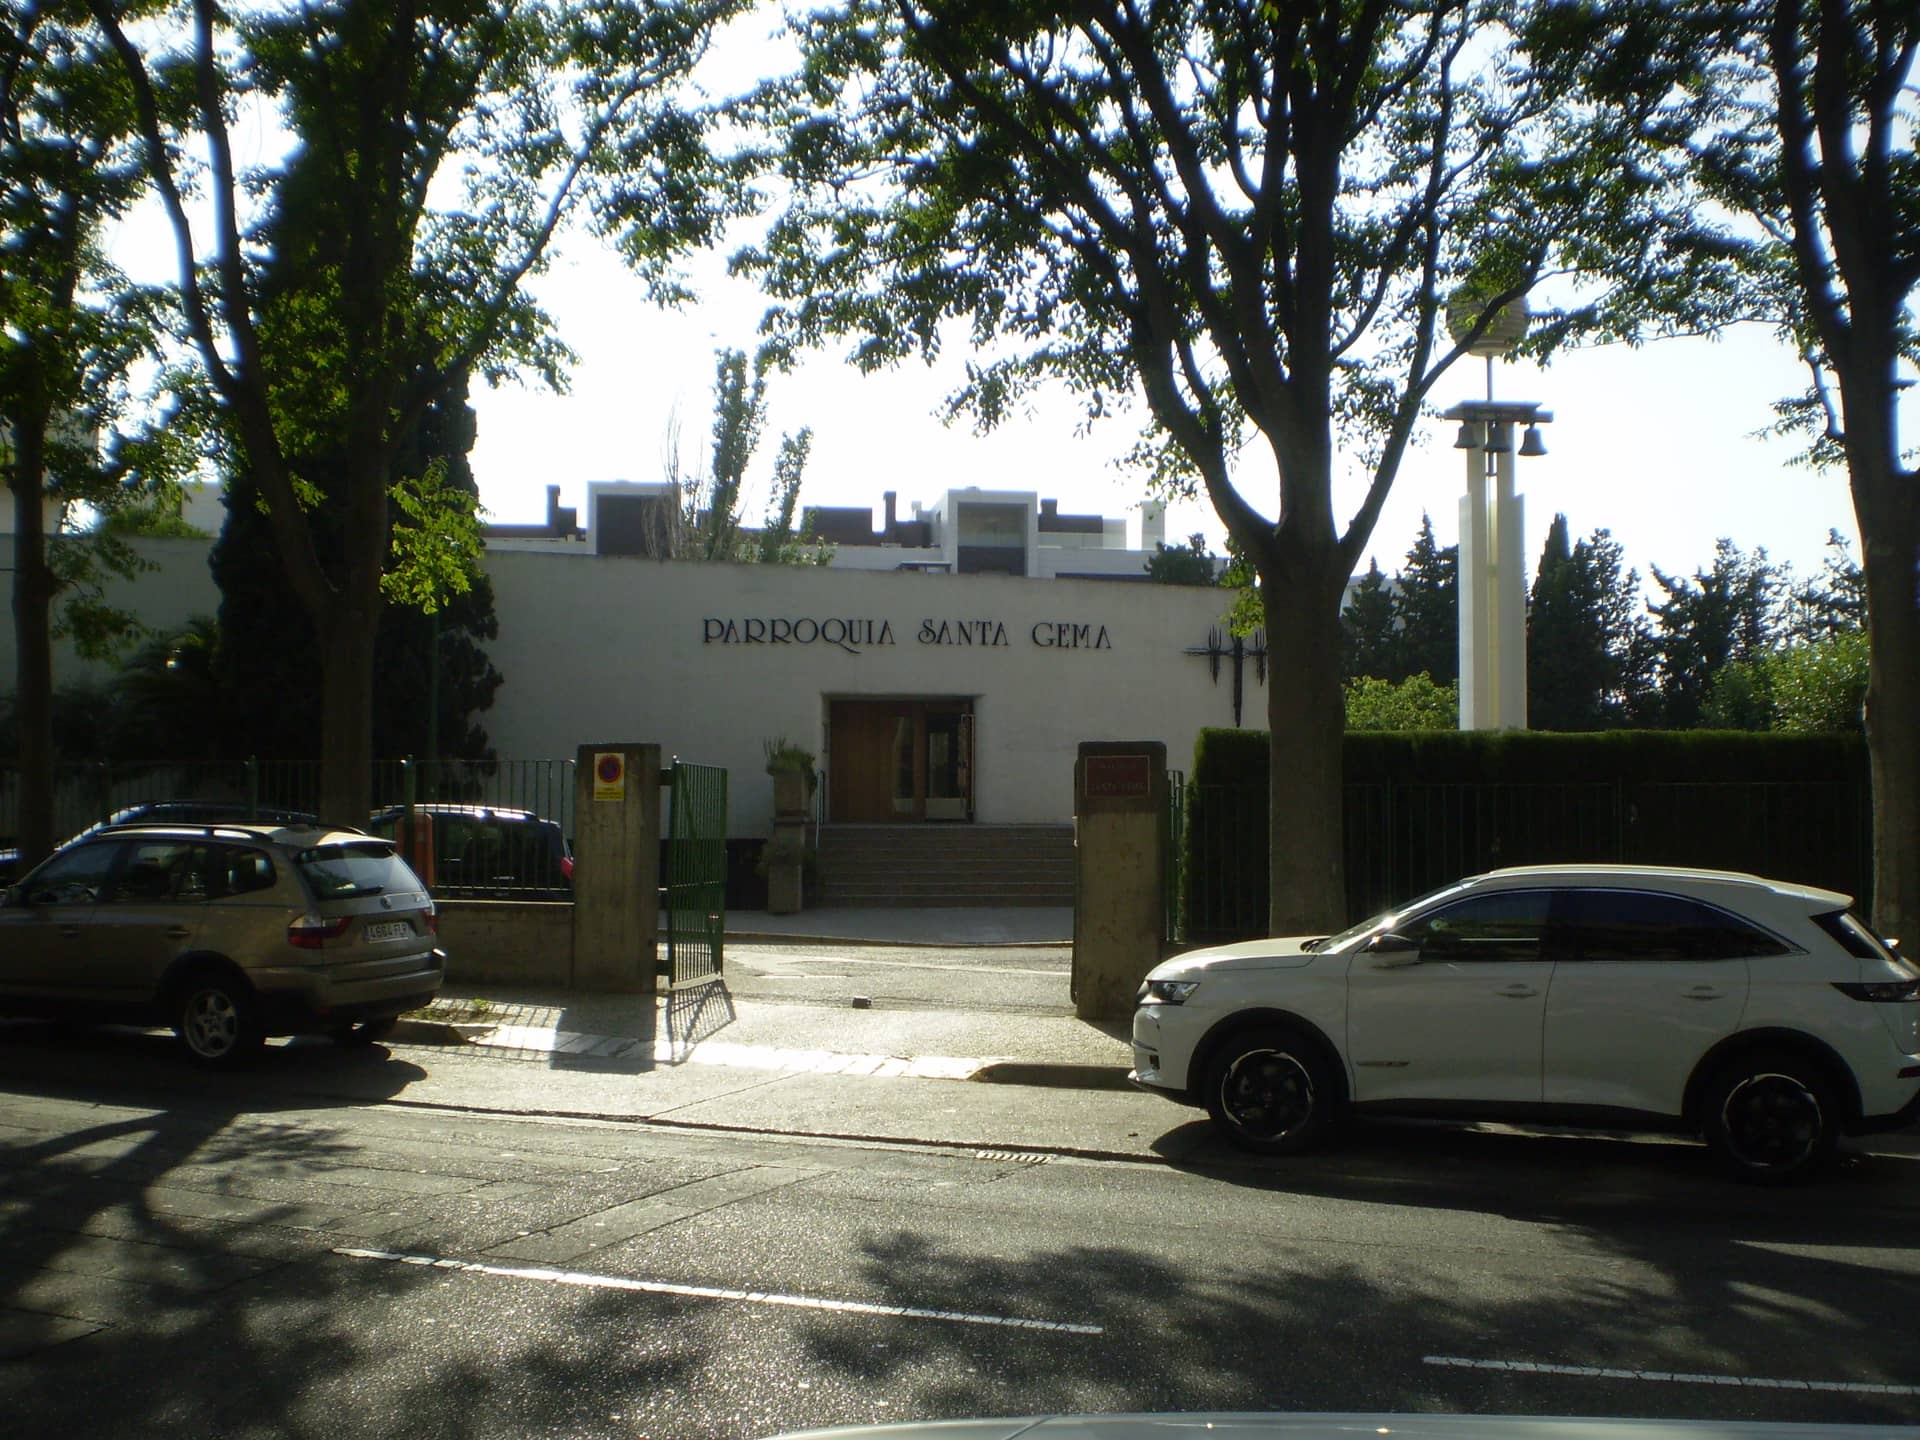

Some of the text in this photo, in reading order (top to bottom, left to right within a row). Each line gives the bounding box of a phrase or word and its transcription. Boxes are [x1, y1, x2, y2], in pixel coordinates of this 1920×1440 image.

[703, 618, 1112, 654] PARROQUIA SANTA GEMA
